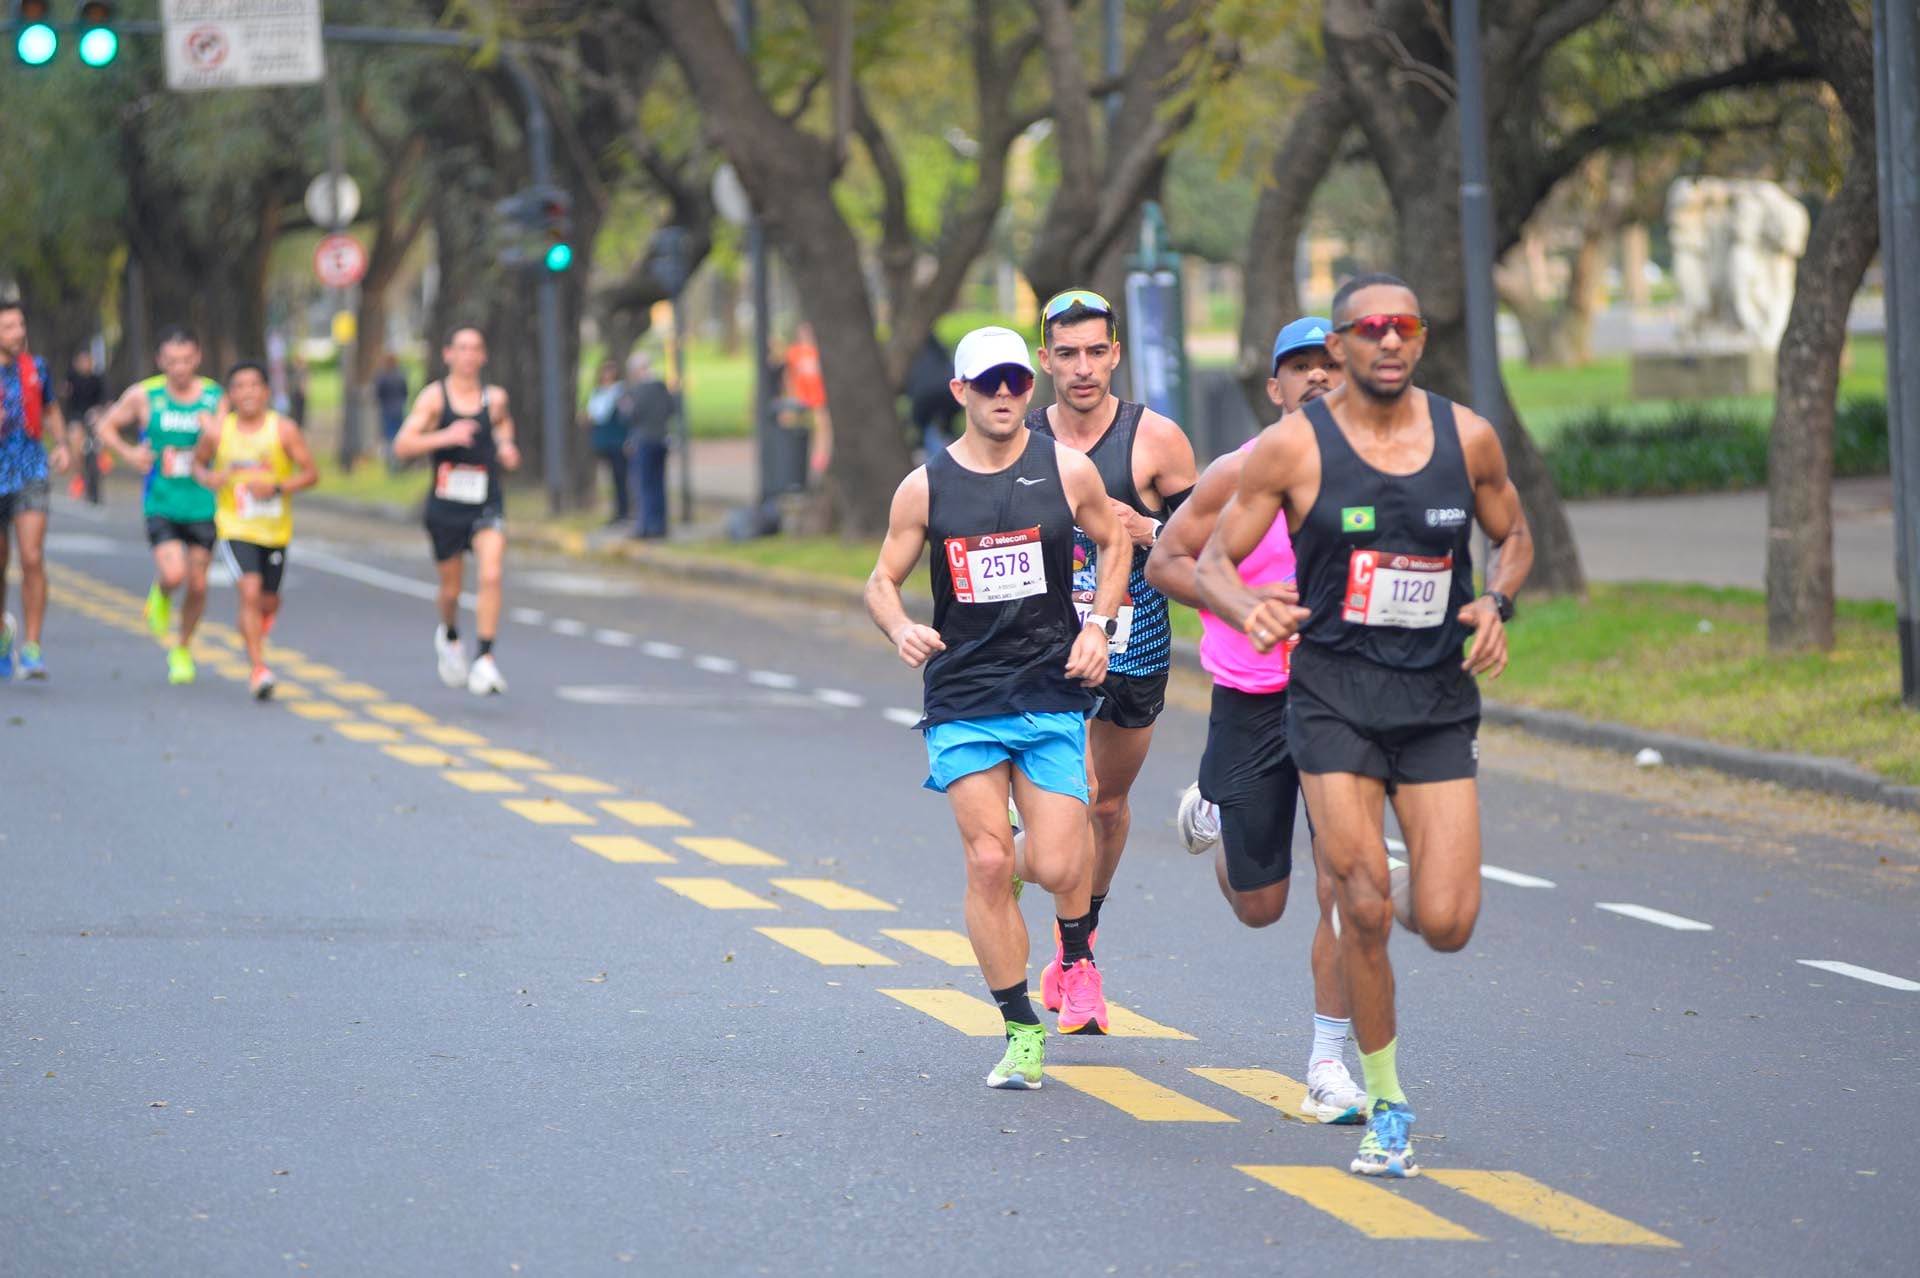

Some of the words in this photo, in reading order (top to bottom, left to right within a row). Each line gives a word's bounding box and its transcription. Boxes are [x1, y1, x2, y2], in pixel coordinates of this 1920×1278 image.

[995, 534, 1028, 545] telecom
[949, 541, 965, 568] C
[981, 551, 1031, 579] 2578
[1410, 560, 1445, 569] telecom
[1353, 553, 1373, 584] C
[1392, 579, 1436, 603] 1120
